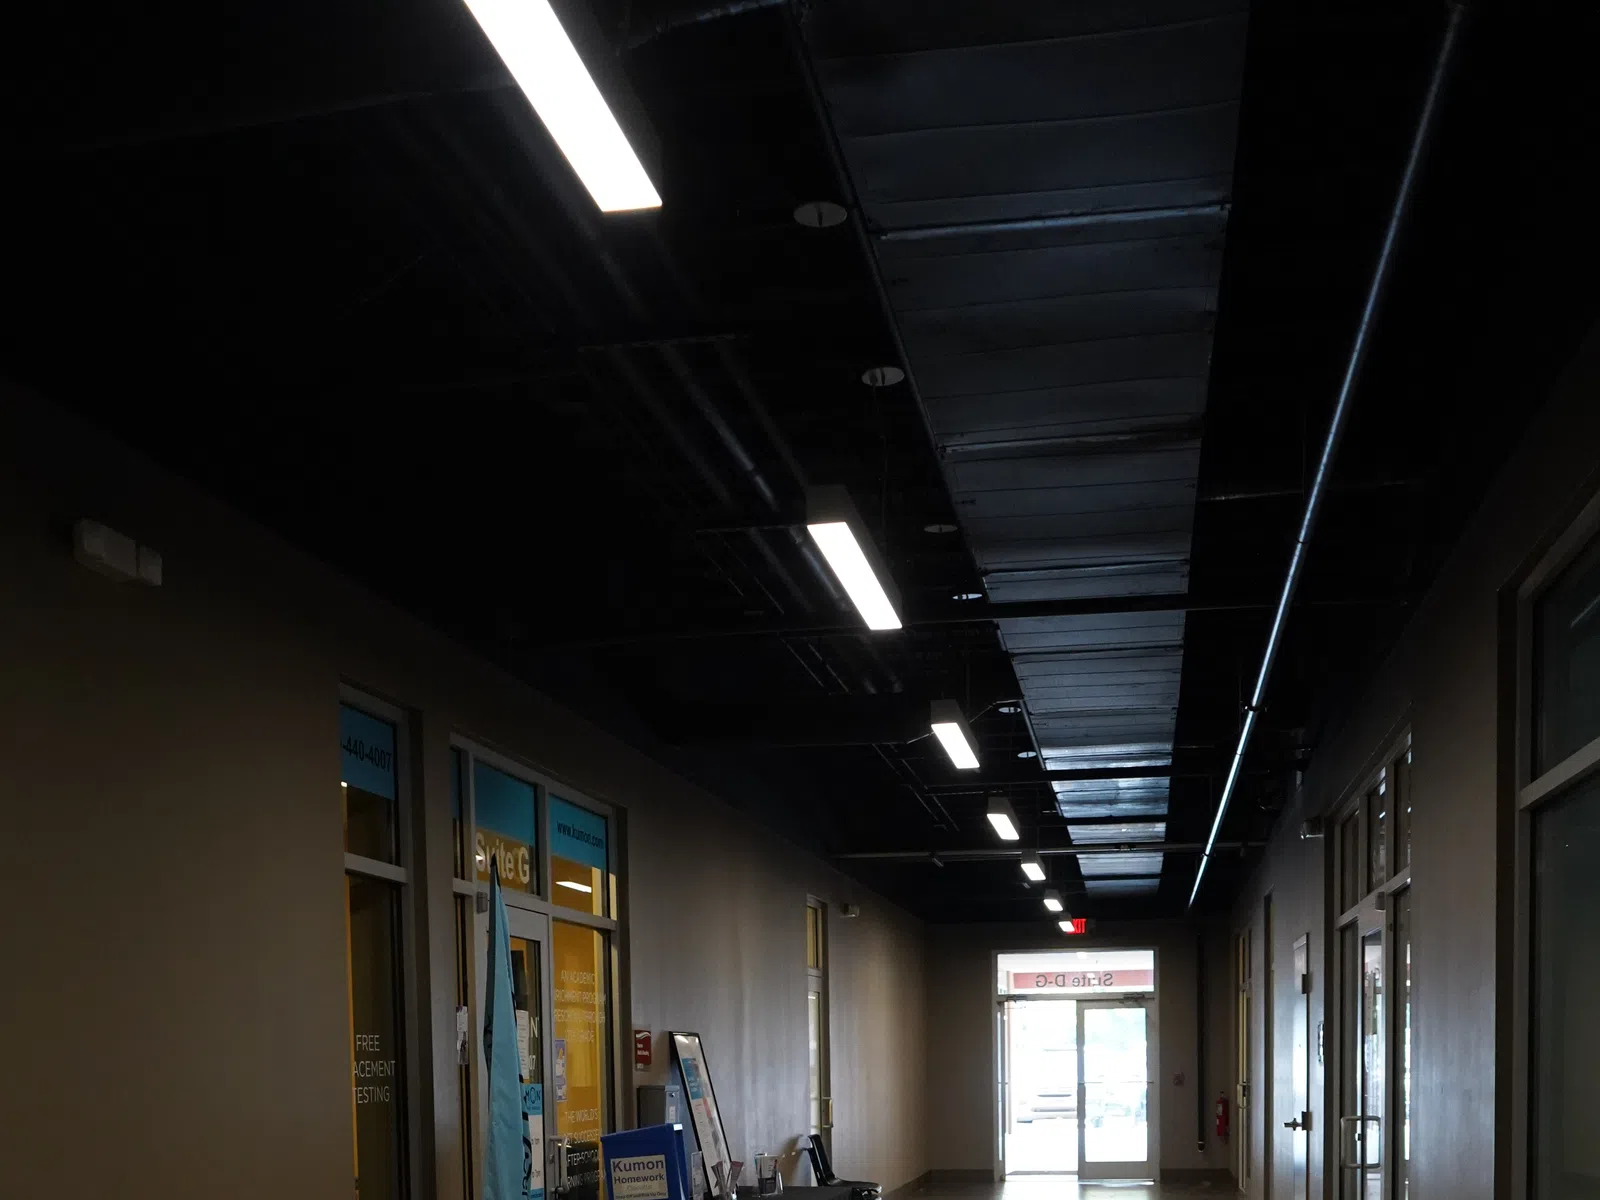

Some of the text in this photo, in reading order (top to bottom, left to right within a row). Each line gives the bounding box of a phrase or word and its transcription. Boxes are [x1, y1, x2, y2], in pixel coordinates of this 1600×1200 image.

[475, 832, 530, 884] Suite G
[1066, 918, 1087, 934] XIT
[355, 1034, 381, 1051] FREE
[353, 1060, 397, 1078] ACEMENT
[351, 1085, 391, 1105] TESTING
[613, 1160, 664, 1173] Kumon
[614, 1173, 665, 1185] Homework
